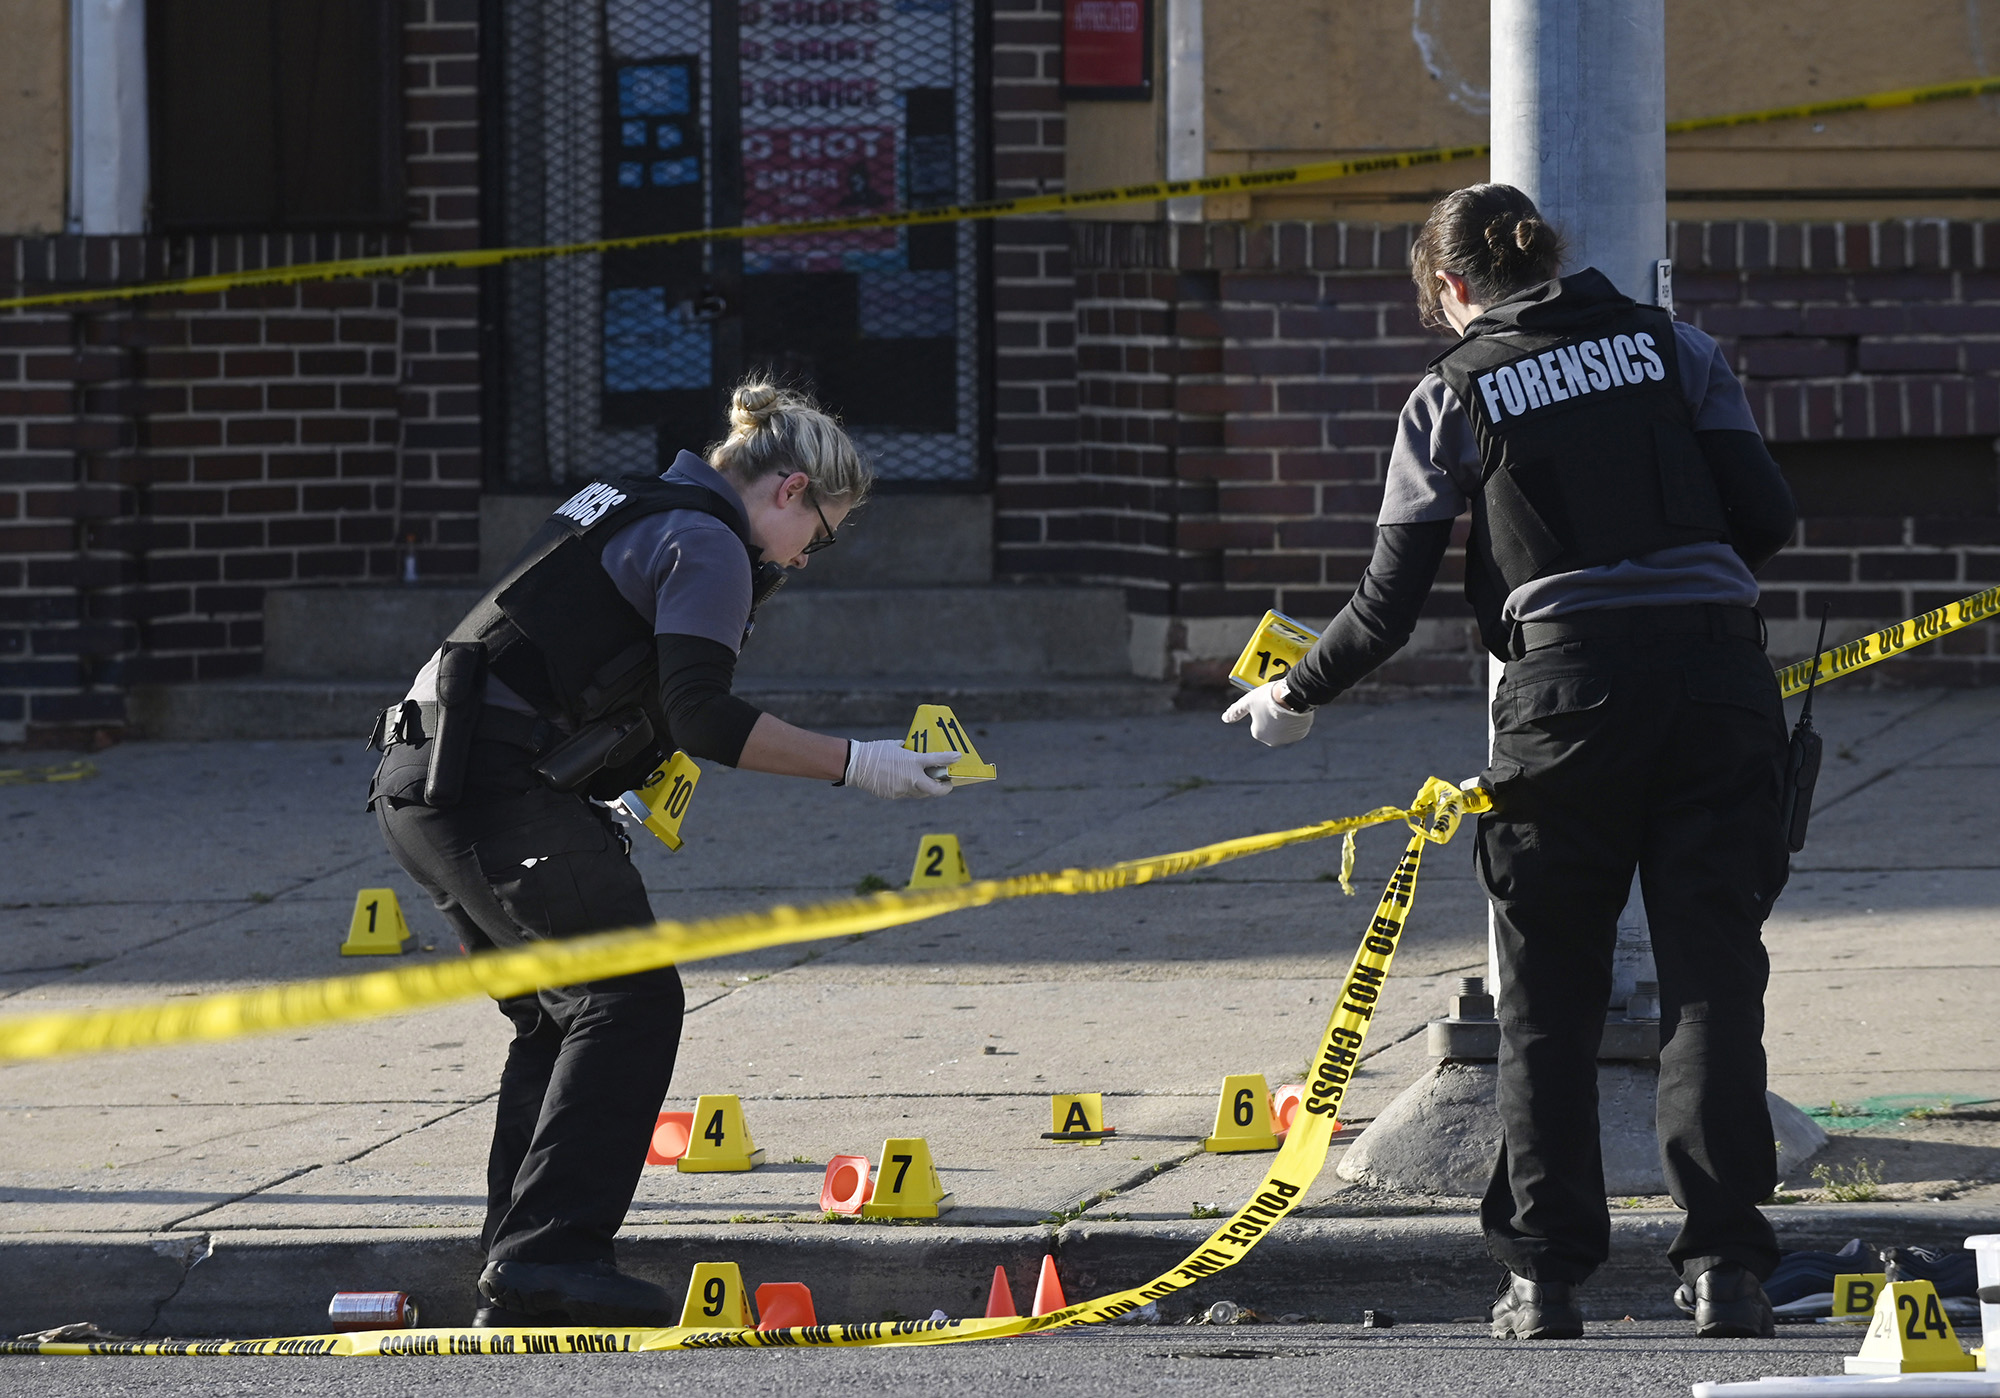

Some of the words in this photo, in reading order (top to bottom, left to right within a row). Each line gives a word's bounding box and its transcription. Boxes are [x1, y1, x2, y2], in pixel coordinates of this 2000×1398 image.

[1477, 332, 1665, 424] FORENSICS
[1256, 650, 1292, 682] 12
[911, 728, 928, 754] 11
[936, 716, 970, 754] 11
[663, 773, 693, 820] 10
[924, 844, 944, 877] 2
[365, 900, 378, 933] 1
[1365, 915, 1401, 956] DO
[1342, 963, 1385, 1021] NOT
[1306, 1026, 1363, 1118] CROSS
[1063, 1101, 1091, 1132] A
[1233, 1088, 1254, 1127] 6
[704, 1109, 725, 1147] 4
[892, 1155, 913, 1194] 7
[1217, 1178, 1301, 1248] POLICE
[1173, 1248, 1235, 1281] LINE
[702, 1277, 726, 1317] 9
[1139, 1280, 1178, 1301] DO
[1846, 1281, 1875, 1313] B
[1874, 1310, 1892, 1339] 24
[1898, 1293, 1948, 1340] 24
